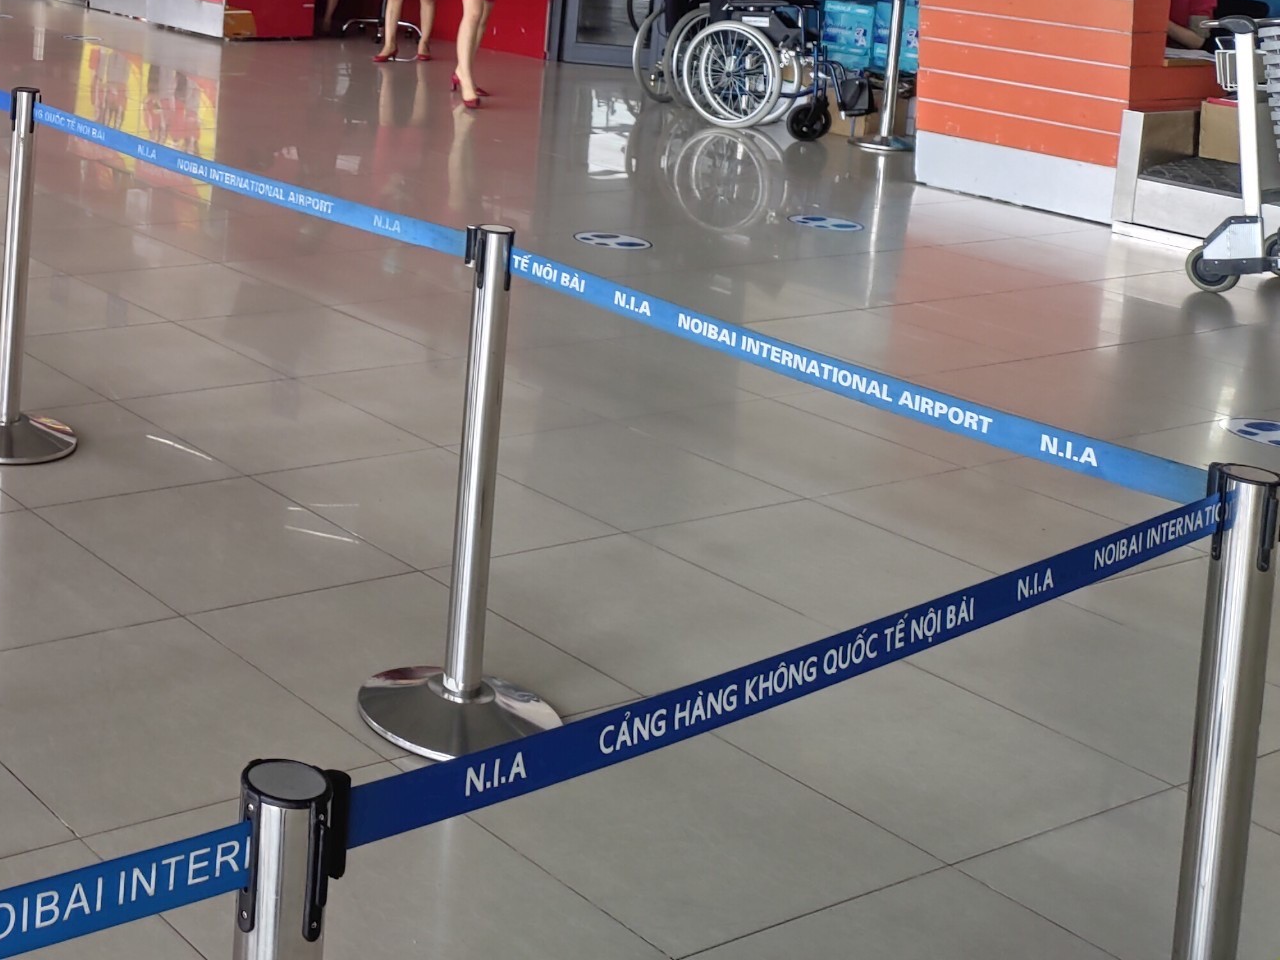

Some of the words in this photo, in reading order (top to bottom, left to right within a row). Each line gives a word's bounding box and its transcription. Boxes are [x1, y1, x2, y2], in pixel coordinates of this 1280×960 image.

[137, 144, 157, 160] N.I.A
[176, 158, 208, 178] NOIBAI
[209, 167, 285, 201] INTERNATIONAL
[287, 191, 334, 214] AIRPORT
[373, 214, 401, 234] N.I.A
[513, 253, 529, 272] TẾ
[560, 271, 586, 293] BÀI
[614, 291, 651, 317] N.I.A
[677, 313, 737, 347] NOIBAI
[741, 335, 892, 402] INTERNATIONAL
[898, 390, 993, 434] AIRPORT
[1040, 434, 1098, 467] N.I.A
[465, 751, 527, 797] N.I.A
[598, 709, 667, 756] CẢNG
[673, 685, 738, 731] HÀNG
[744, 656, 818, 706] KHÔNG
[822, 629, 878, 677] QUỐC
[884, 615, 907, 651] TẾ
[910, 606, 943, 644] NỘI
[945, 595, 976, 630] BÀI
[1017, 567, 1055, 602] N.I.A
[1093, 532, 1143, 570] NOIBAI
[1146, 502, 1222, 550] INTERNATIO
